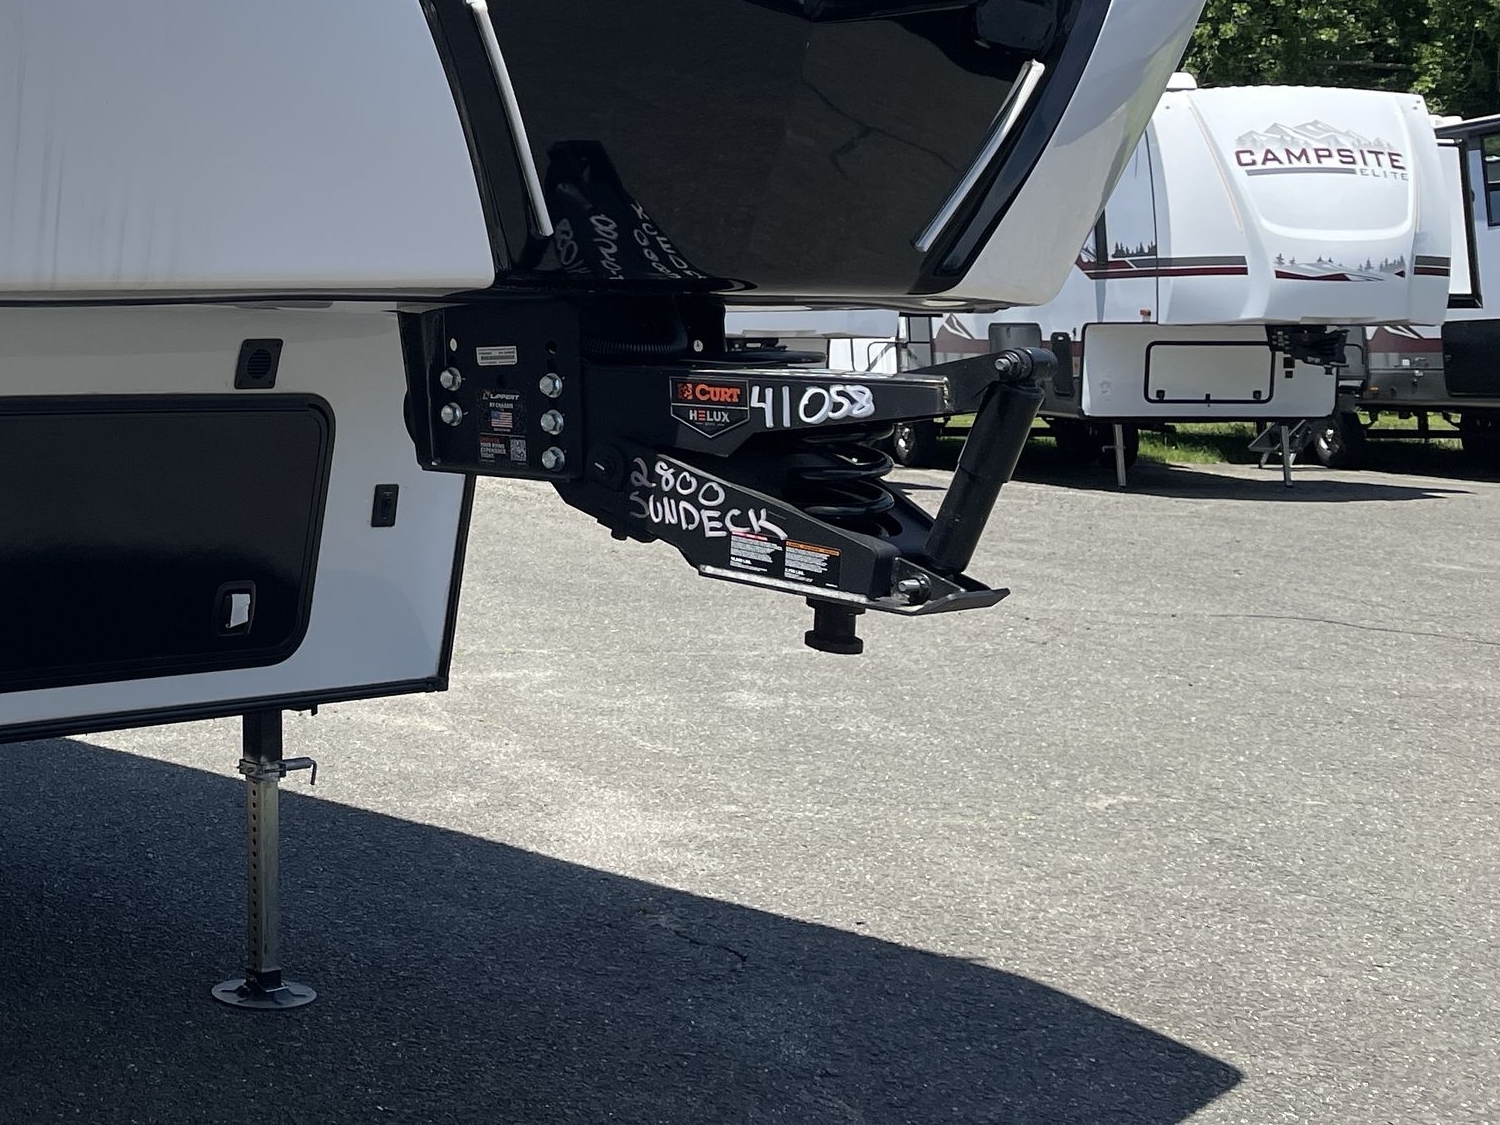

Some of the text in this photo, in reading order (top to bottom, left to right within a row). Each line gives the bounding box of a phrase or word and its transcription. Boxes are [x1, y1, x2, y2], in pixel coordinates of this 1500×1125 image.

[1234, 147, 1408, 171] CAMPSITE
[1359, 168, 1409, 181] ELITE
[695, 383, 741, 403] CURT
[689, 409, 730, 423] HELUX
[631, 457, 725, 507] 2800
[629, 490, 788, 541] SUNDECK
